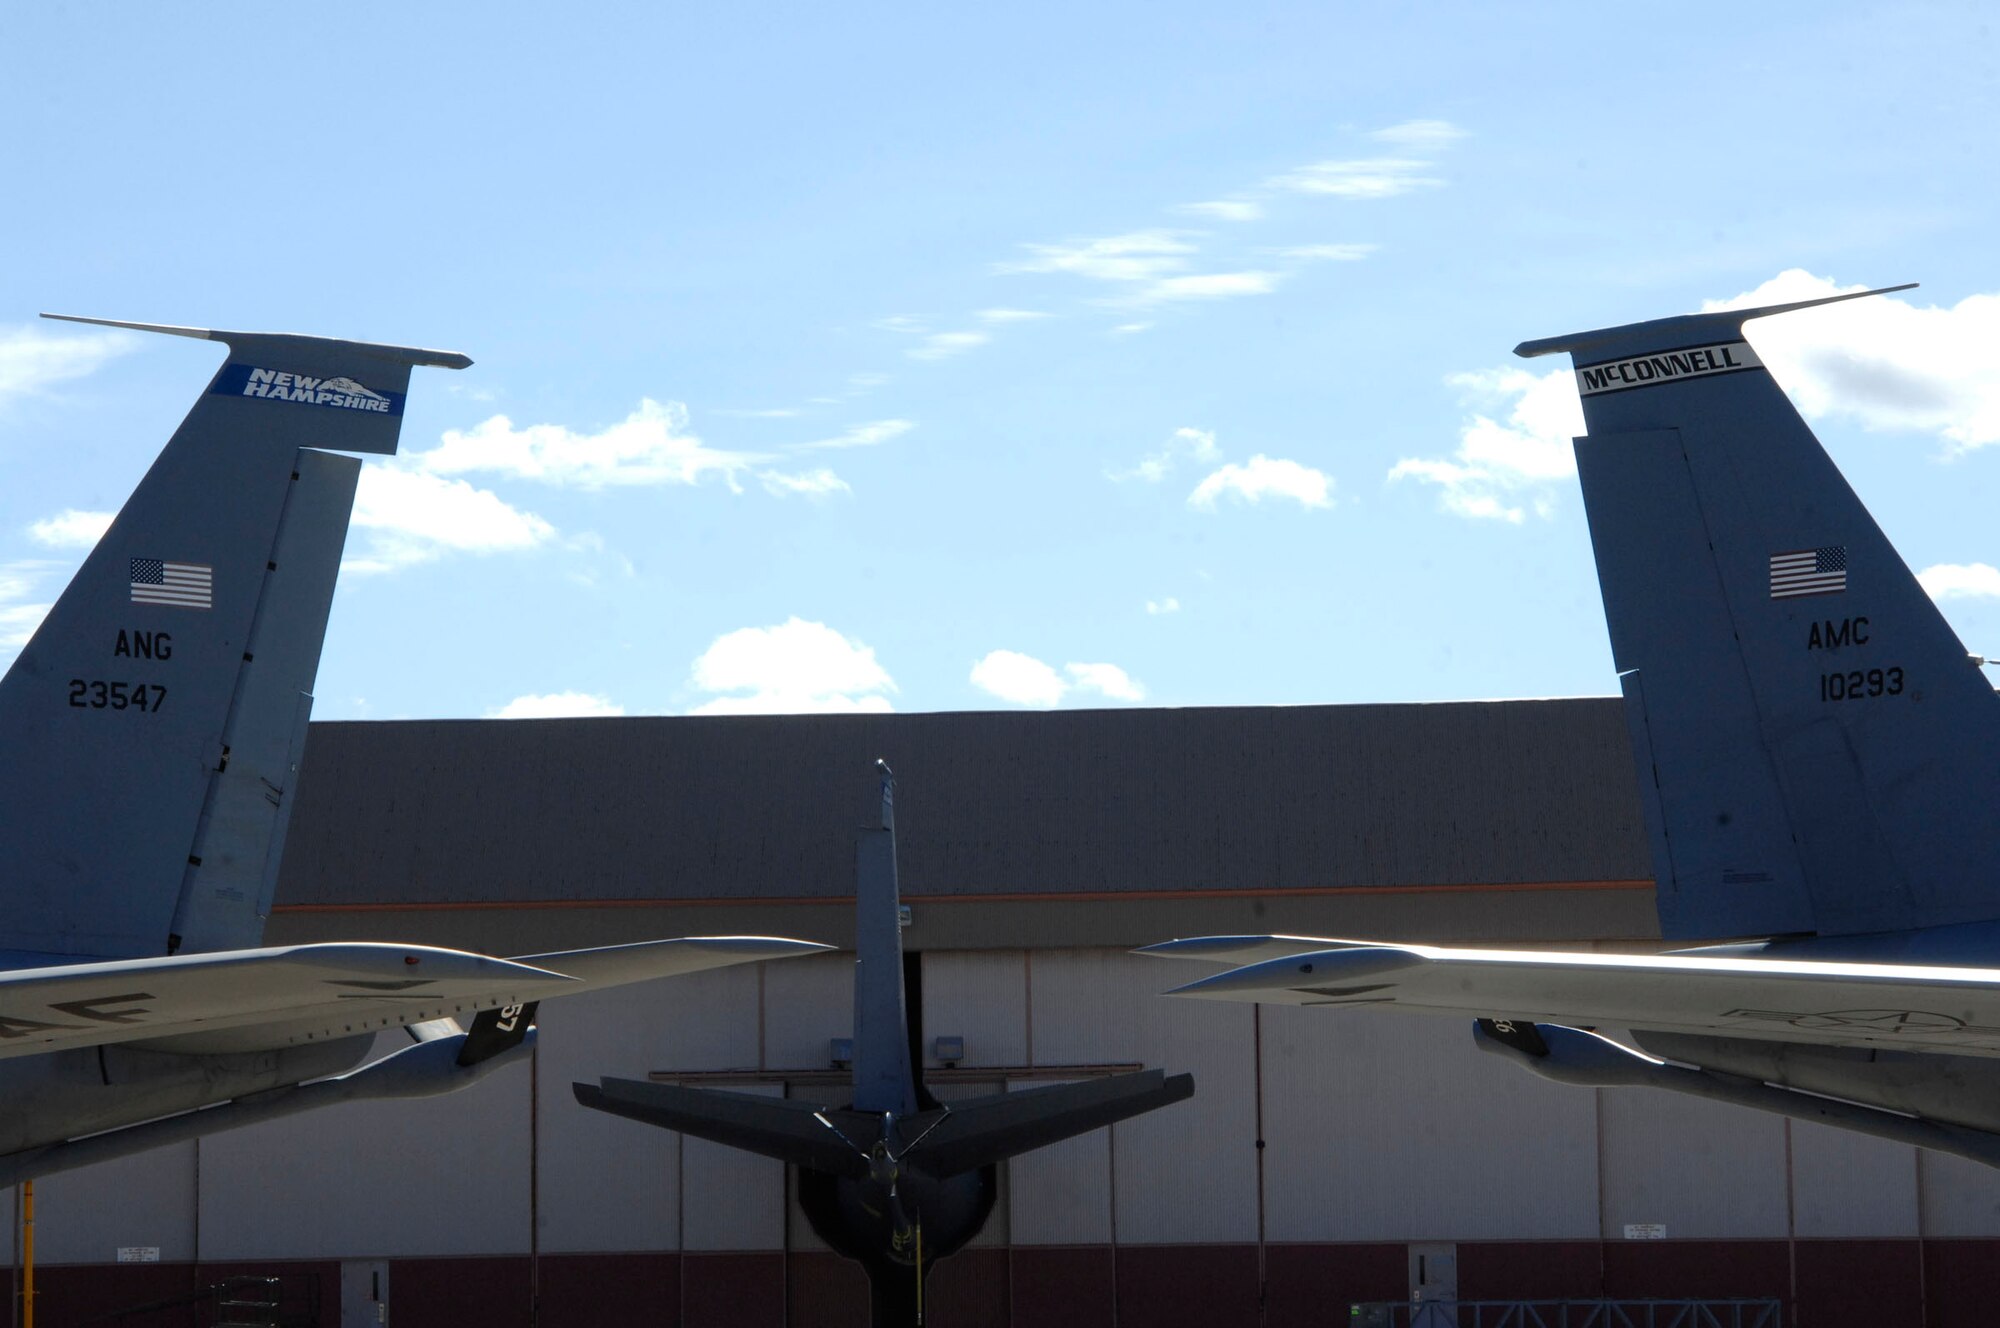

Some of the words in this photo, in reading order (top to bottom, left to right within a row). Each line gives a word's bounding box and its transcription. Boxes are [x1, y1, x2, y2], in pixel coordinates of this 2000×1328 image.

[248, 368, 322, 390] NEW
[243, 381, 391, 412] HAMPSHIRE
[114, 629, 172, 660] ANG
[1808, 617, 1869, 650] AMC
[69, 679, 167, 713] 23547
[1821, 666, 1904, 702] 10293
